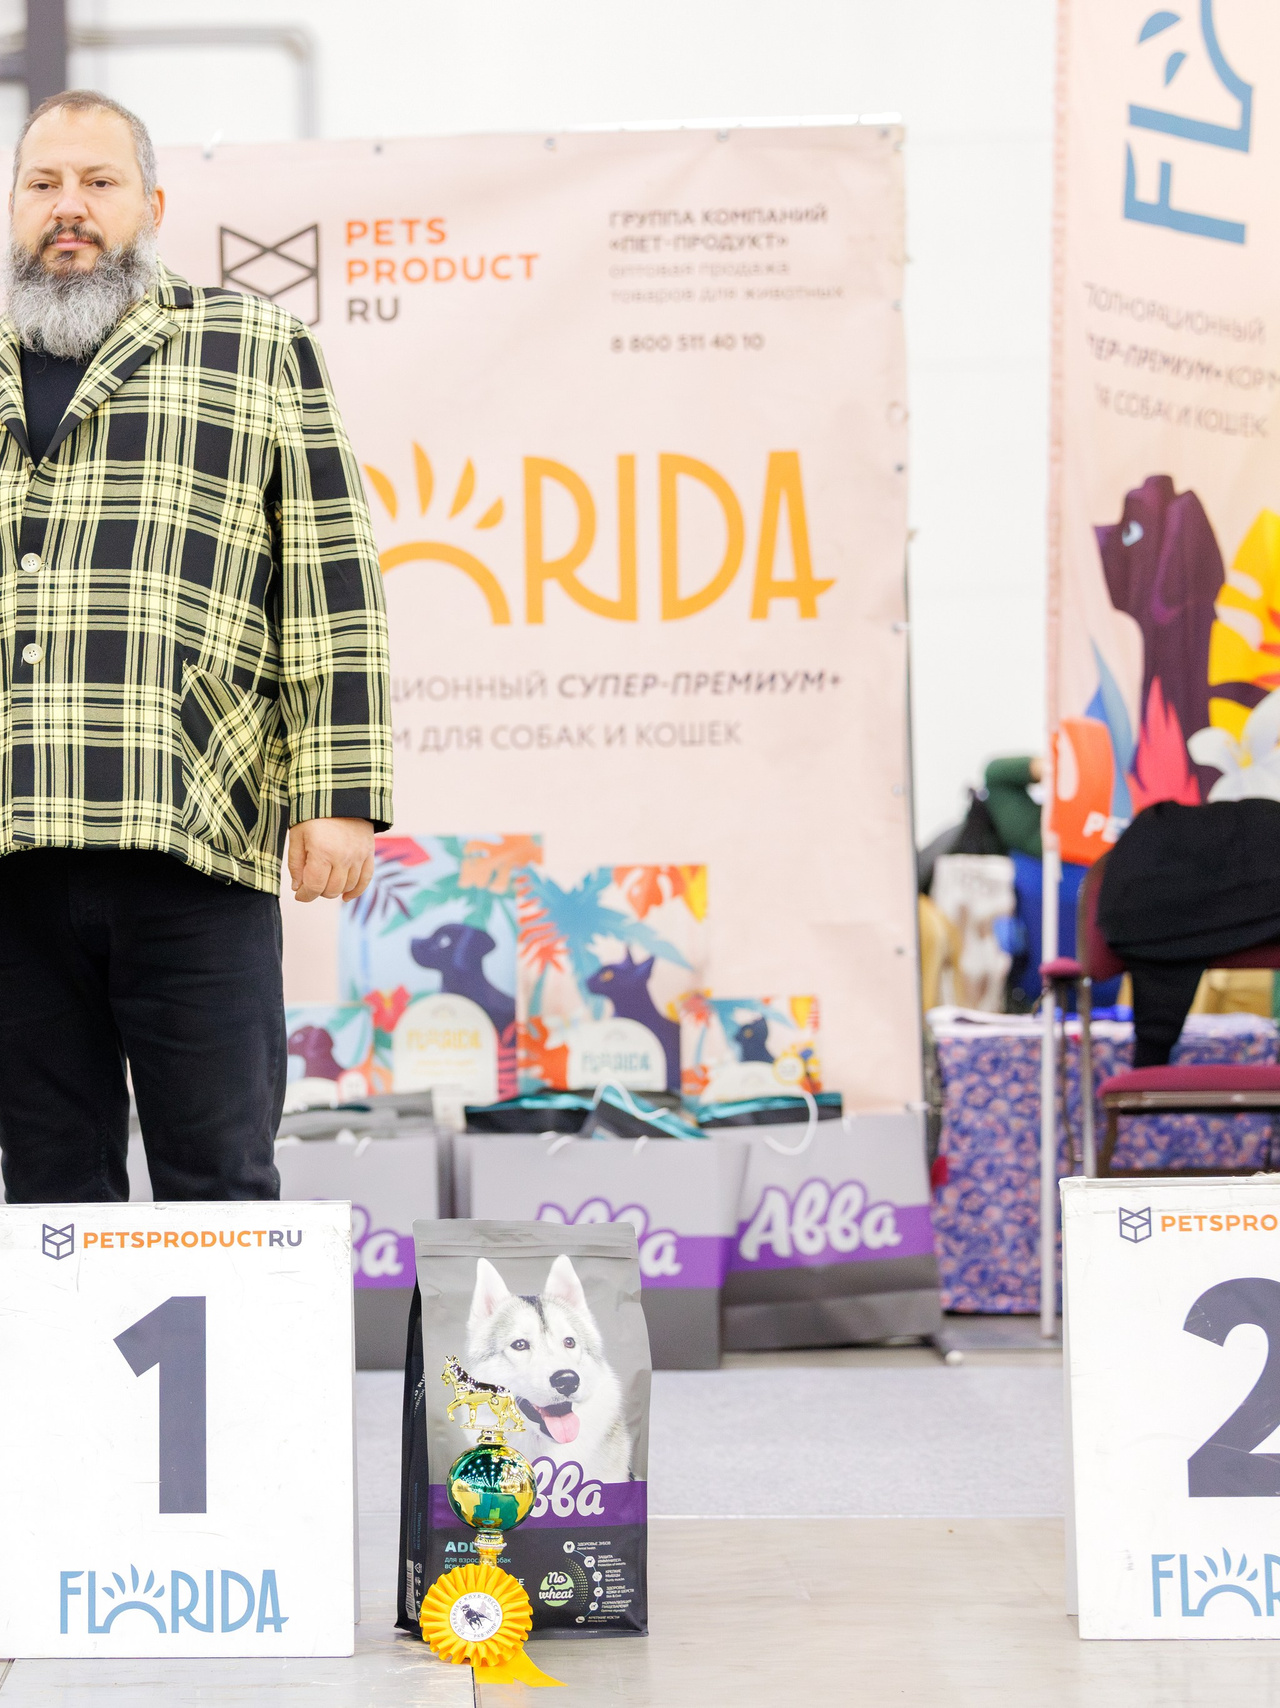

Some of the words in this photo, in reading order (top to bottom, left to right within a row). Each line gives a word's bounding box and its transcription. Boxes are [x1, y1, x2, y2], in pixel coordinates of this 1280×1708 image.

[609, 210, 694, 228] ГРУППА
[700, 204, 828, 226] КОМПАНИЙ
[346, 218, 447, 246] PETS
[347, 253, 539, 284] PRODUCT
[348, 297, 399, 324] RU
[610, 335, 624, 353] 8
[629, 334, 672, 352] 800
[677, 333, 706, 351] 511
[710, 332, 737, 351] 40
[742, 332, 766, 350] 10
[557, 671, 842, 700] СУПЕР-ПРЕМИУМ+
[419, 725, 483, 754] ДЛЯ
[489, 723, 597, 752] СОБАК
[604, 723, 626, 749] И
[634, 721, 742, 748] КОШЕК
[1161, 1214, 1278, 1232] PETSPRO
[83, 1229, 303, 1249] PETSPRODUCTRU
[1182, 1277, 1280, 1498] 2
[113, 1295, 207, 1514] 1
[547, 1572, 566, 1583] No
[60, 1563, 290, 1634] FLORIDA
[538, 1587, 574, 1599] wheat
